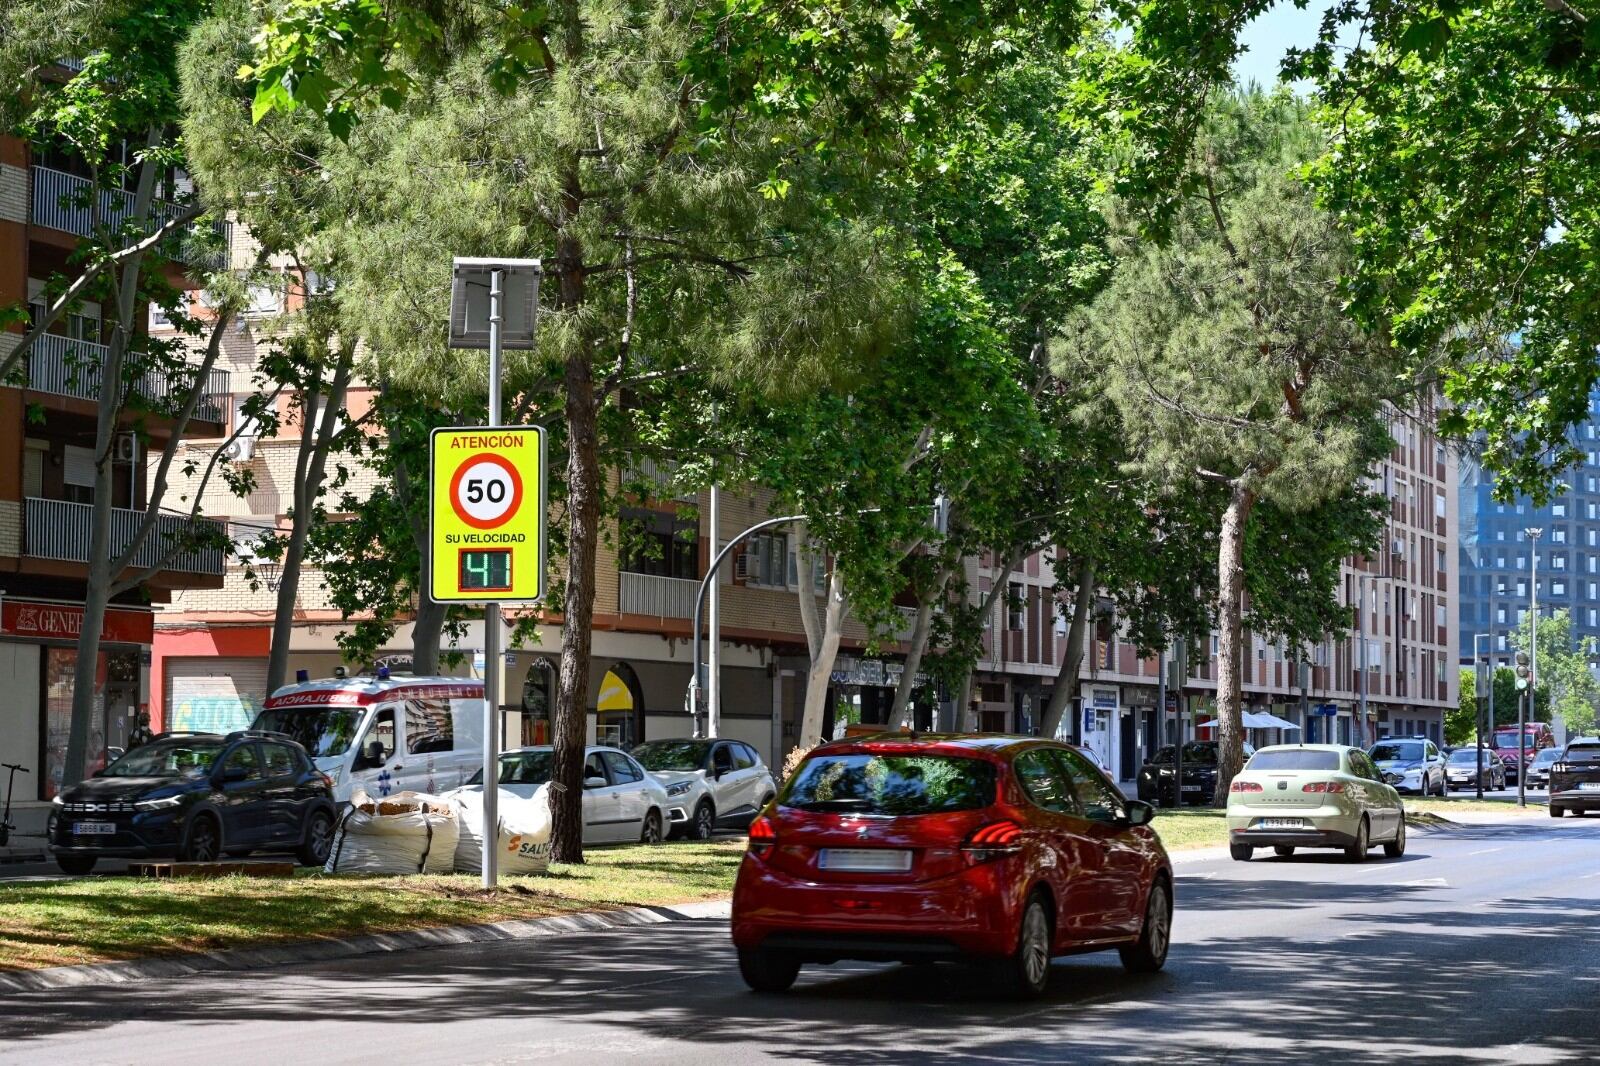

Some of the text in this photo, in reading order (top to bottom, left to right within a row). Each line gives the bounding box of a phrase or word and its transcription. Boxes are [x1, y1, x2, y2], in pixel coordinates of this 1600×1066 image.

[451, 433, 524, 448] ATENCIÓN
[467, 479, 506, 504] 50
[445, 533, 526, 544] SU VELOCIDAD
[467, 553, 511, 587] 41
[397, 686, 485, 698] AMBULANCI
